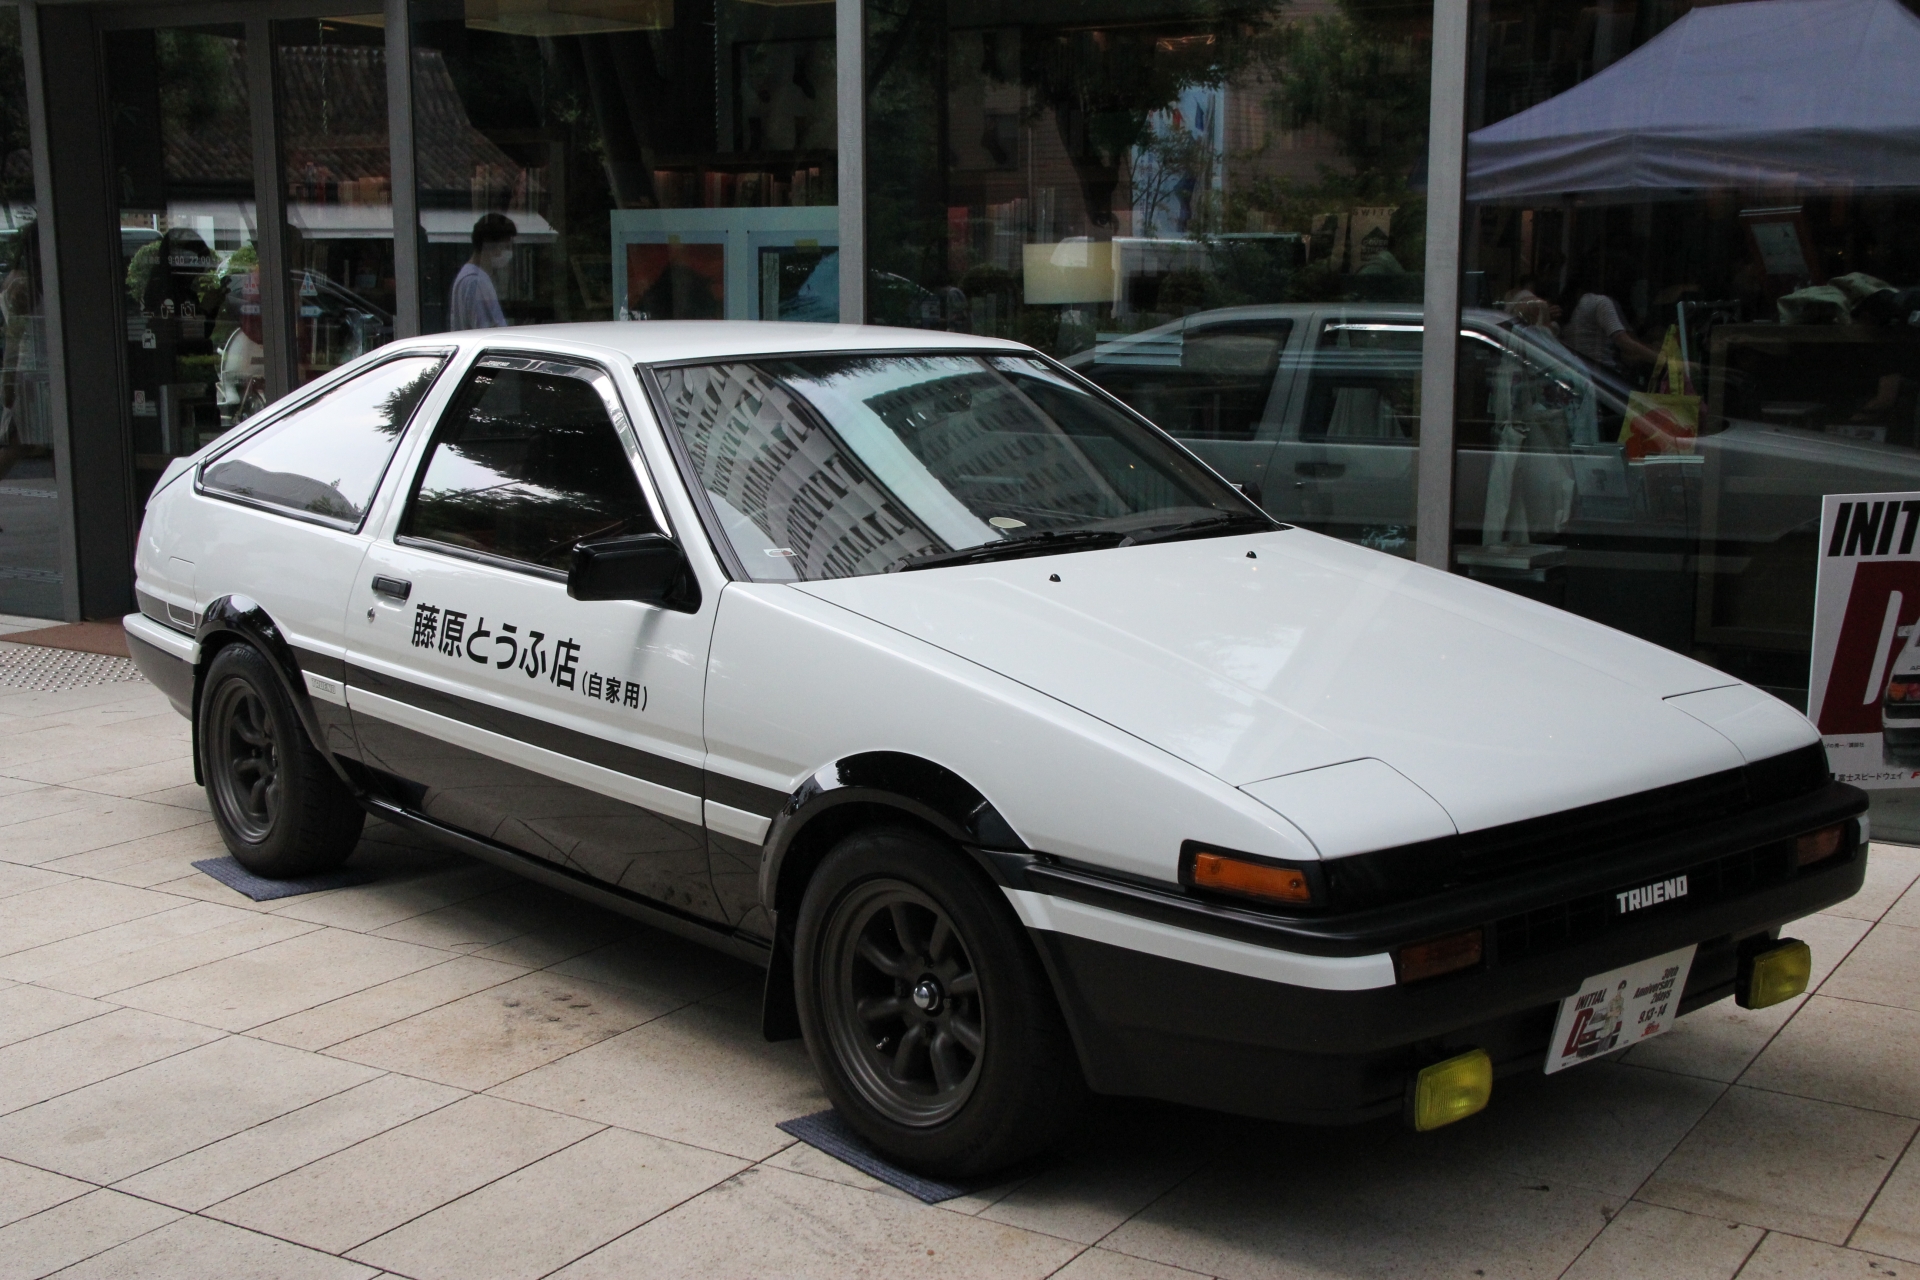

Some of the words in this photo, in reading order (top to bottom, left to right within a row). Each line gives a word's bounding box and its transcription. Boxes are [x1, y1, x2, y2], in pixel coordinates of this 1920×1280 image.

[1828, 501, 1920, 557] INIT
[411, 603, 582, 691] 藤原とうふ店
[1616, 875, 1688, 914] TRUENO
[1574, 988, 1608, 1011] INITIAL
